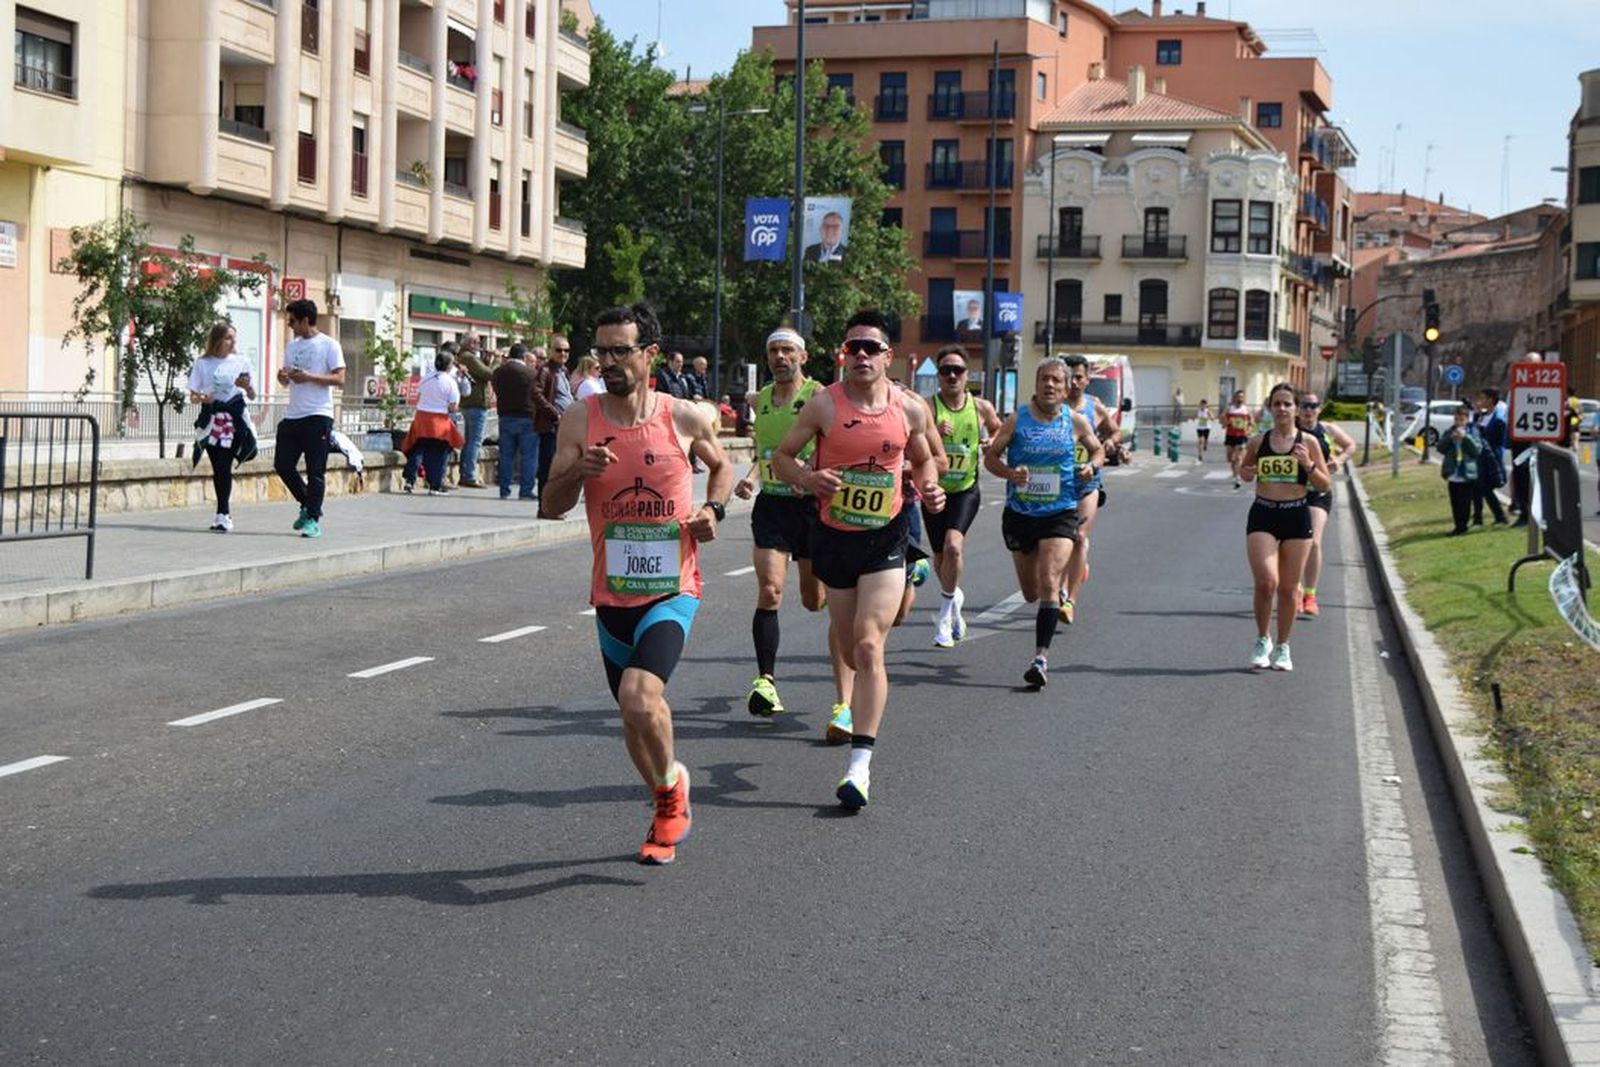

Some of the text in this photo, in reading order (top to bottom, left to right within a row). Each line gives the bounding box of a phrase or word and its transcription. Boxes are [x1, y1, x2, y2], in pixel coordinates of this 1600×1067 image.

[753, 214, 780, 224] VOTA
[1526, 393, 1548, 405] km
[1516, 412, 1558, 431] 459
[1261, 459, 1293, 475] 663
[841, 487, 884, 512] 160
[625, 556, 662, 575] JORGE
